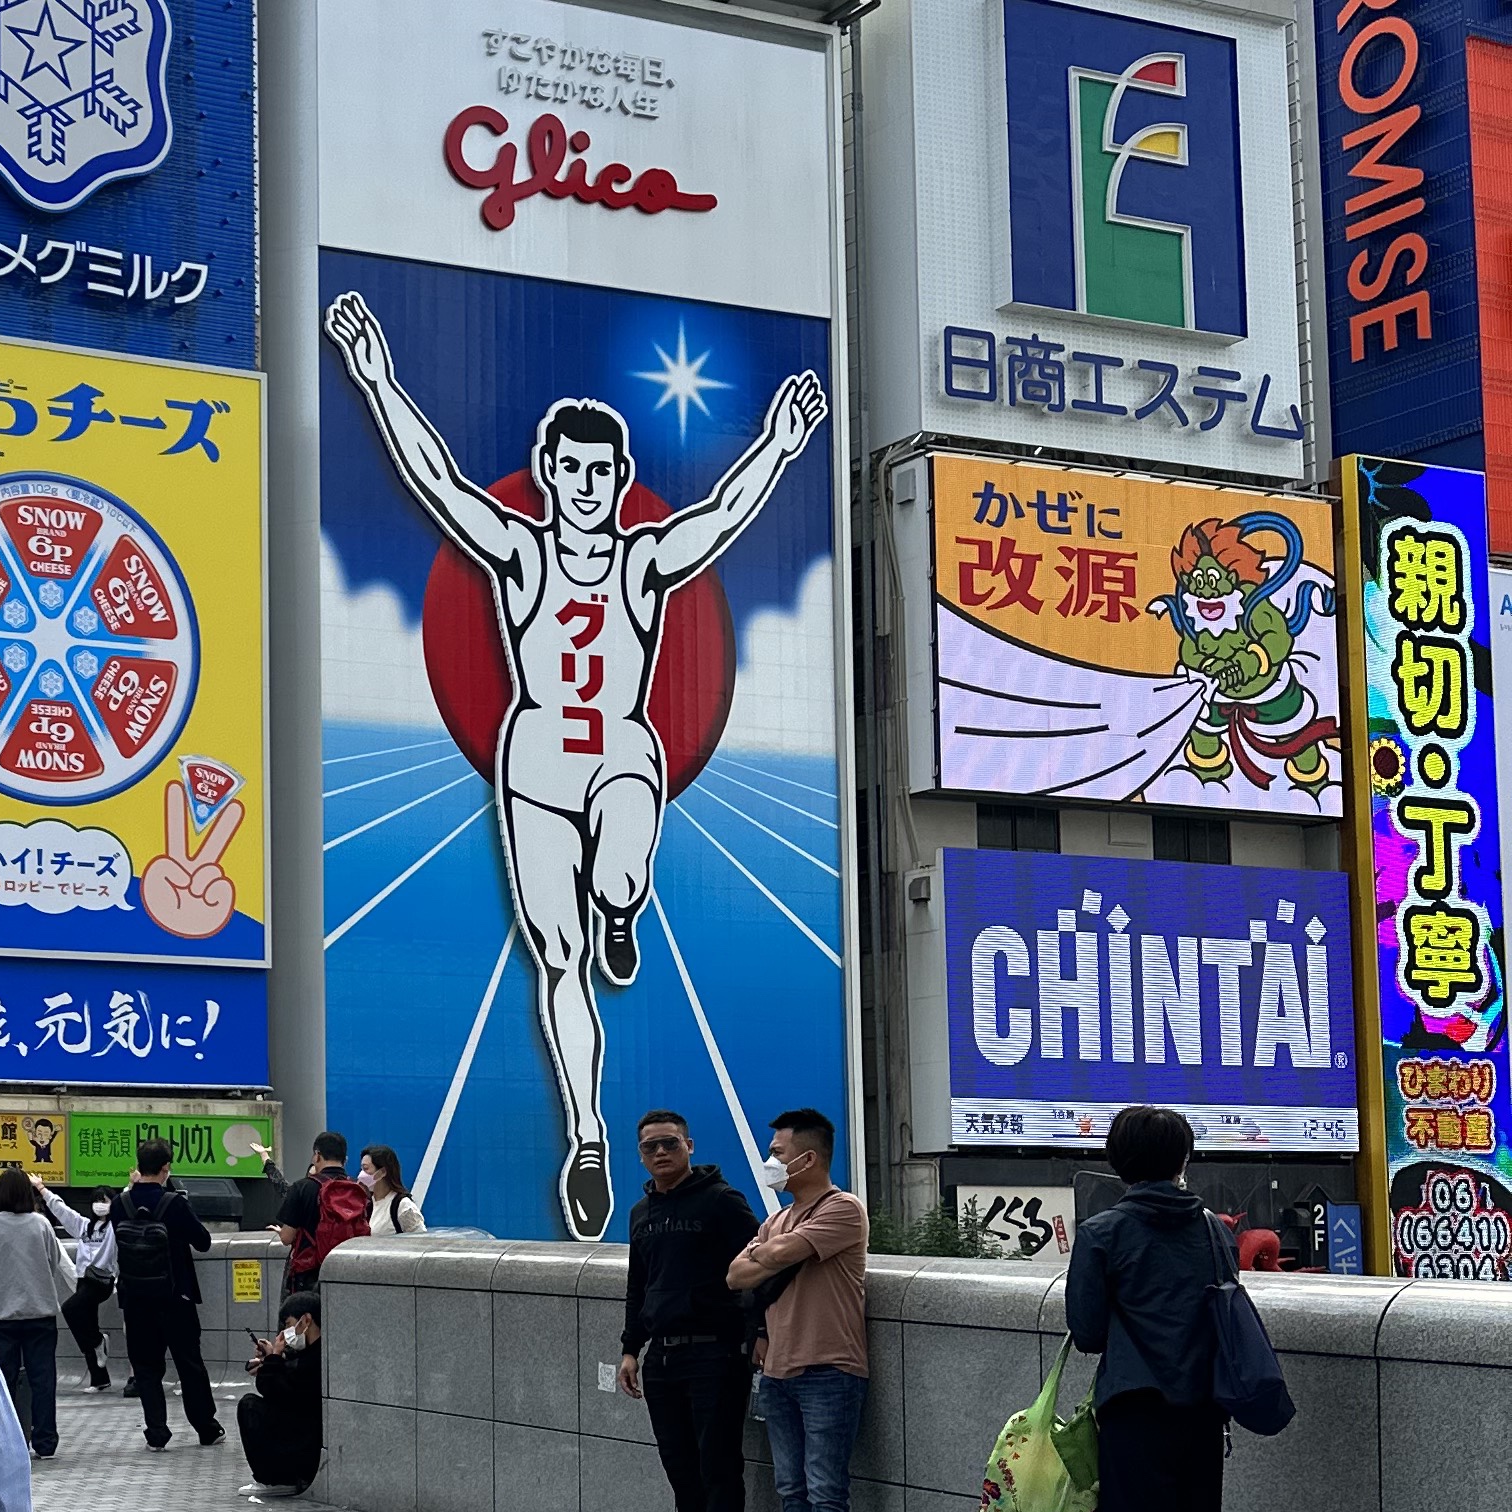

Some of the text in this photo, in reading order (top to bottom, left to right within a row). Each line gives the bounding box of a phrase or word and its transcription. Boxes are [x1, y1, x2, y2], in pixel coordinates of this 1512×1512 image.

[498, 66, 660, 120] ゆたかな人生
[443, 104, 718, 231] Glico
[944, 326, 1305, 441] 日商エステム
[18, 505, 87, 531] SNOW
[972, 480, 1124, 540] かぜに
[36, 527, 67, 537] BRAND
[30, 560, 71, 575] CHEESE
[955, 536, 1142, 624] 改源
[94, 588, 121, 631] CHEESE
[123, 554, 170, 624] SNOW
[94, 660, 121, 701] CHEESE
[555, 593, 608, 756] グリコ
[31, 703, 72, 717] CHEESE
[124, 674, 168, 745] SNOW
[15, 749, 85, 773] SNOW
[35, 741, 66, 751] BRAND
[1392, 532, 1476, 1000] 親切・丁寧
[194, 767, 228, 786] SNOW
[1399, 1061, 1495, 1102] ひまわり
[1400, 1213, 1509, 1254] (6641)
